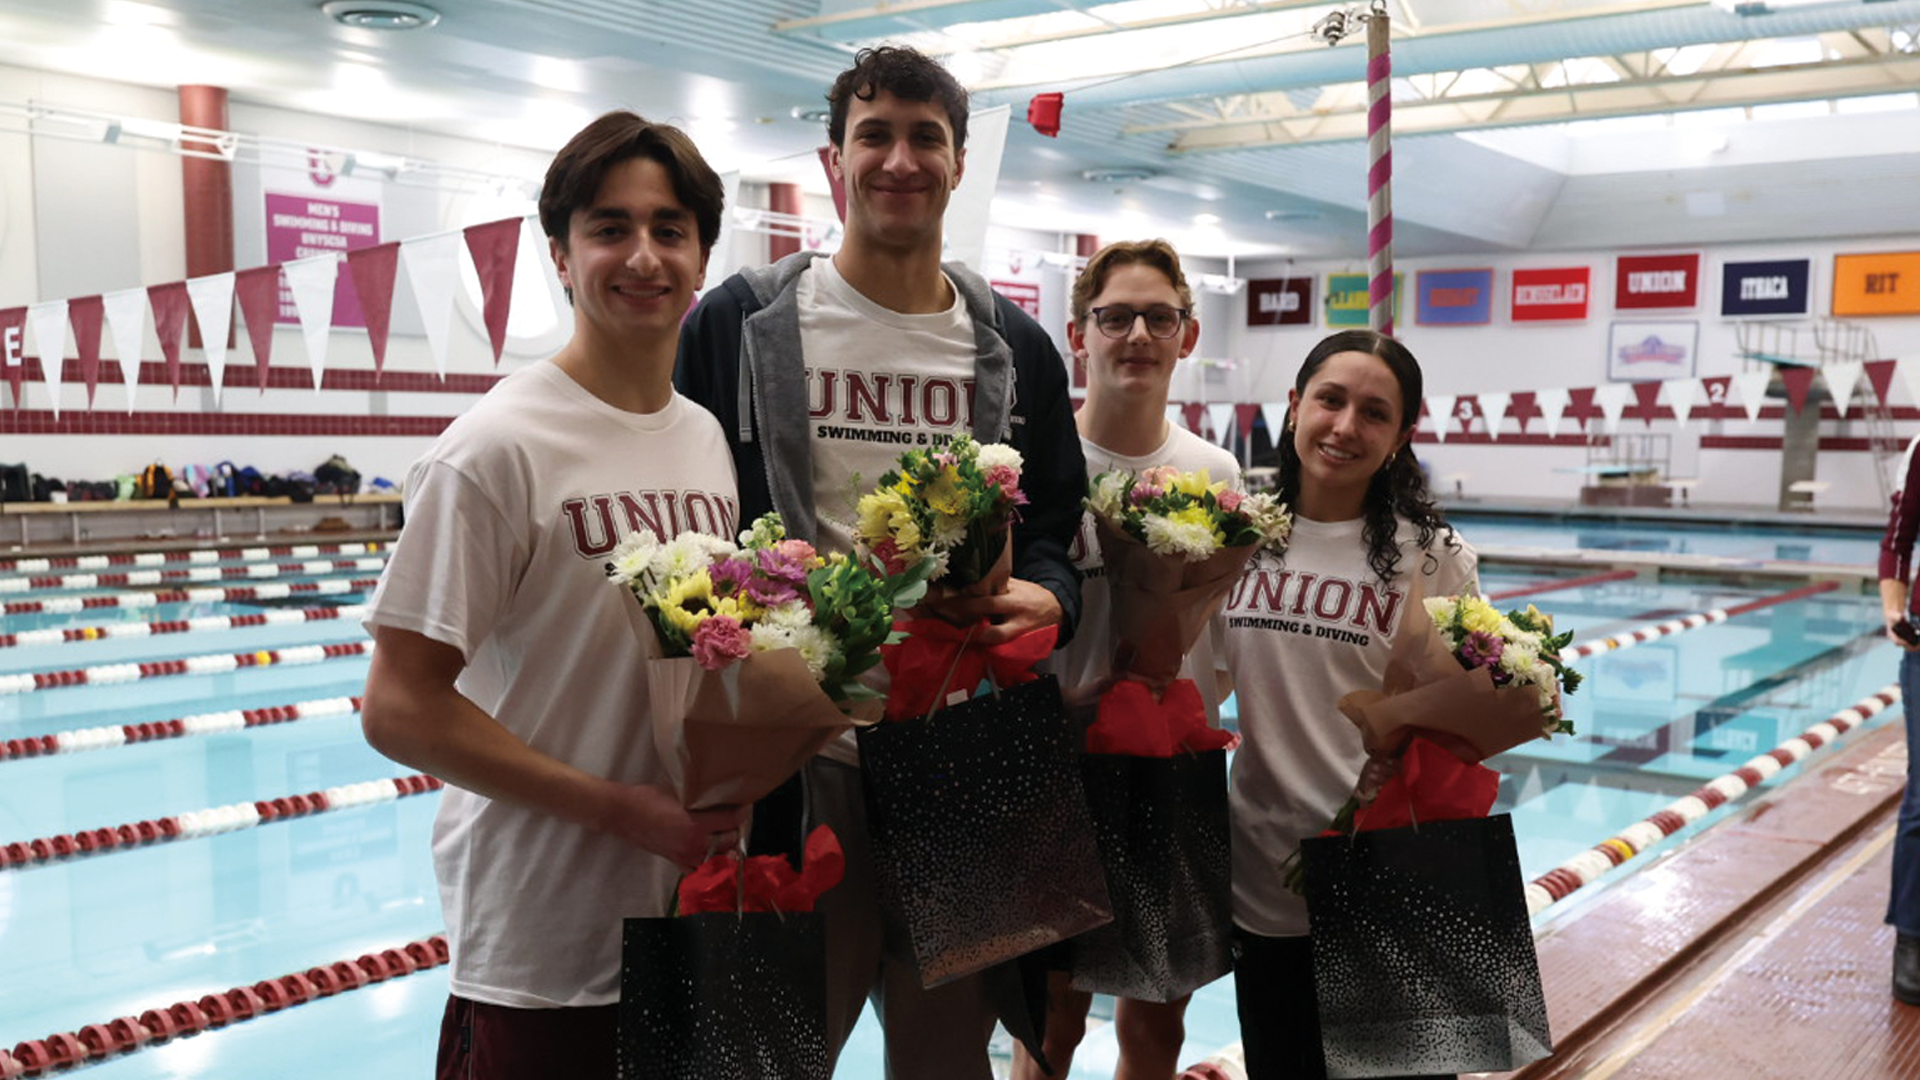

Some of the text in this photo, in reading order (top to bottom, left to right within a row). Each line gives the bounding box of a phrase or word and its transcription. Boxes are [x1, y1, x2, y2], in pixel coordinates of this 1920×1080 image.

[1628, 270, 1687, 294] UNION
[1864, 273, 1900, 294] RIT
[805, 367, 977, 430] UNIO
[1709, 383, 1725, 403] 2
[1459, 402, 1473, 420] 3
[817, 425, 912, 445] SWIMMING
[917, 432, 928, 446] &
[1229, 617, 1370, 647] SWIMMING & DIVING
